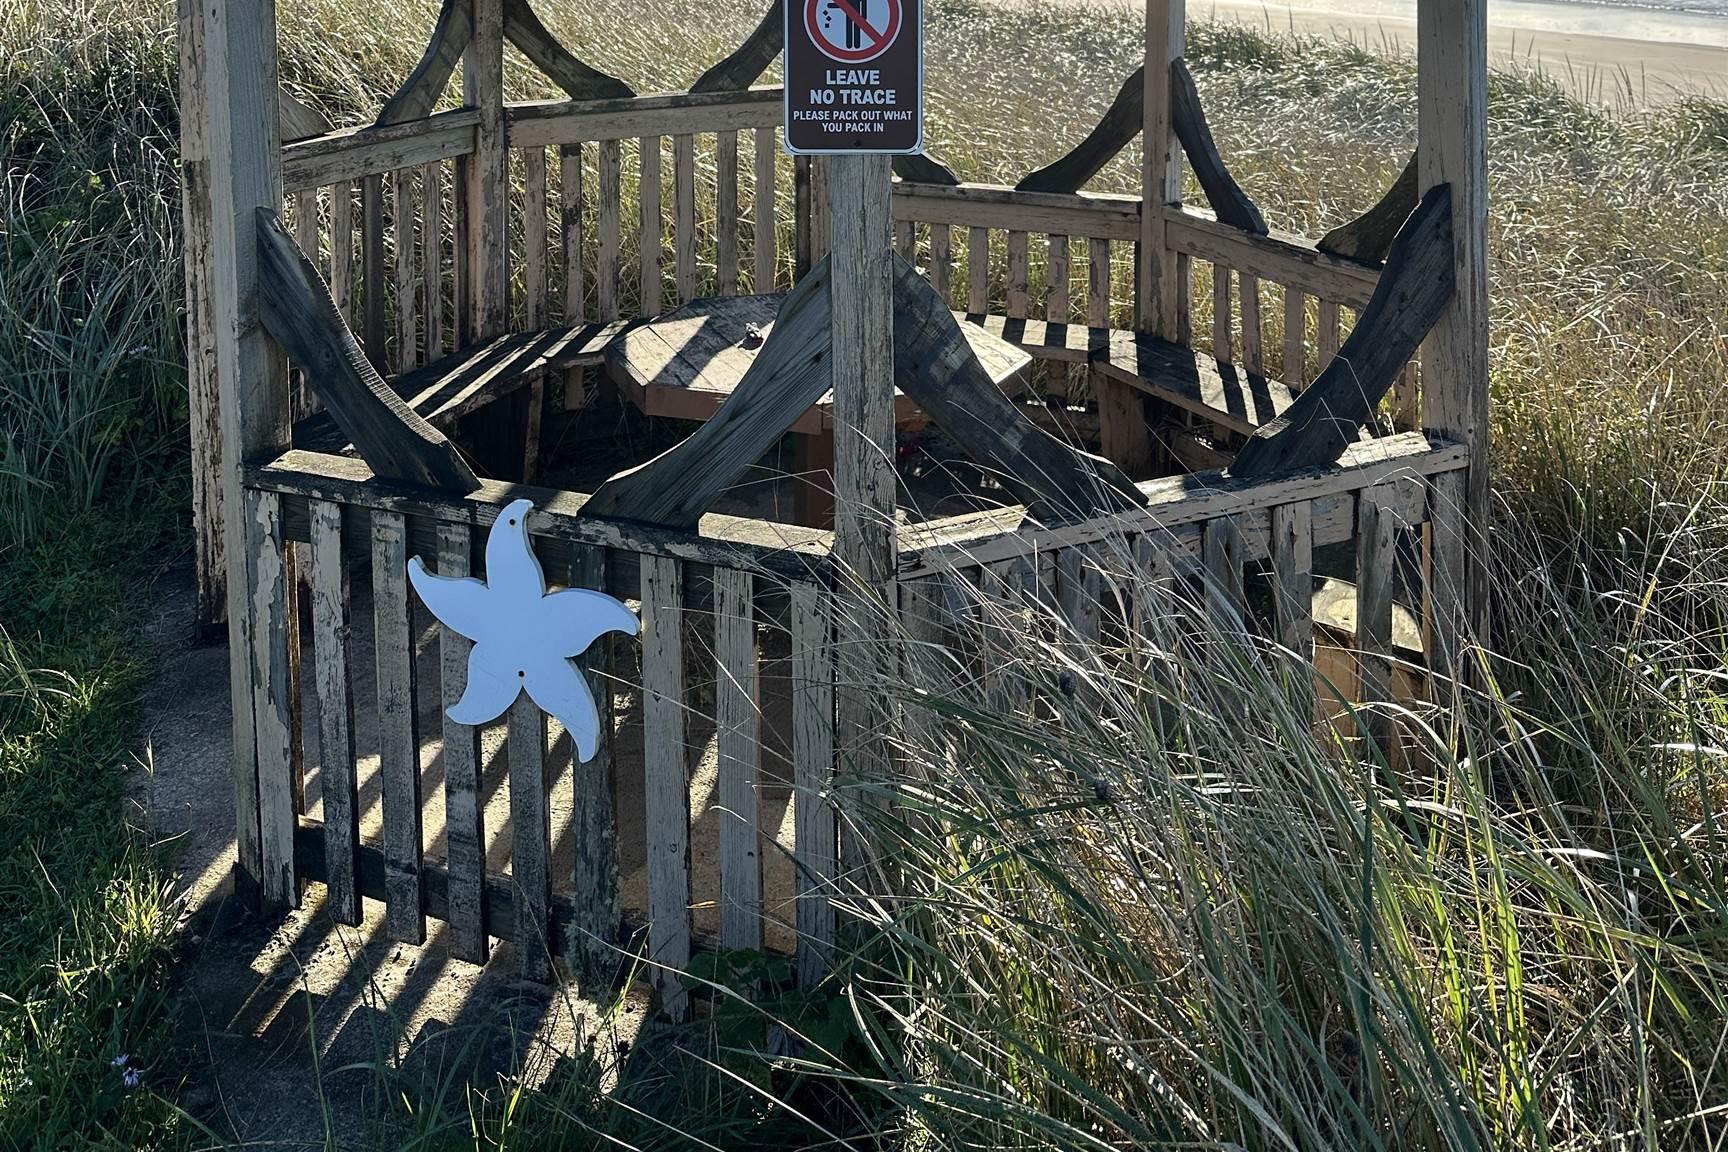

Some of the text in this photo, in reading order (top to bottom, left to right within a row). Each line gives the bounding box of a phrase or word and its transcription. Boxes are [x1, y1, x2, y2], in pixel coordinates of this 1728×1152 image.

[826, 70, 880, 85] LEAVE
[810, 89, 896, 105] NO TRACE
[793, 110, 913, 121] PLEASE PACK OUT WHAT
[821, 122, 884, 133] YOU PACK IN
